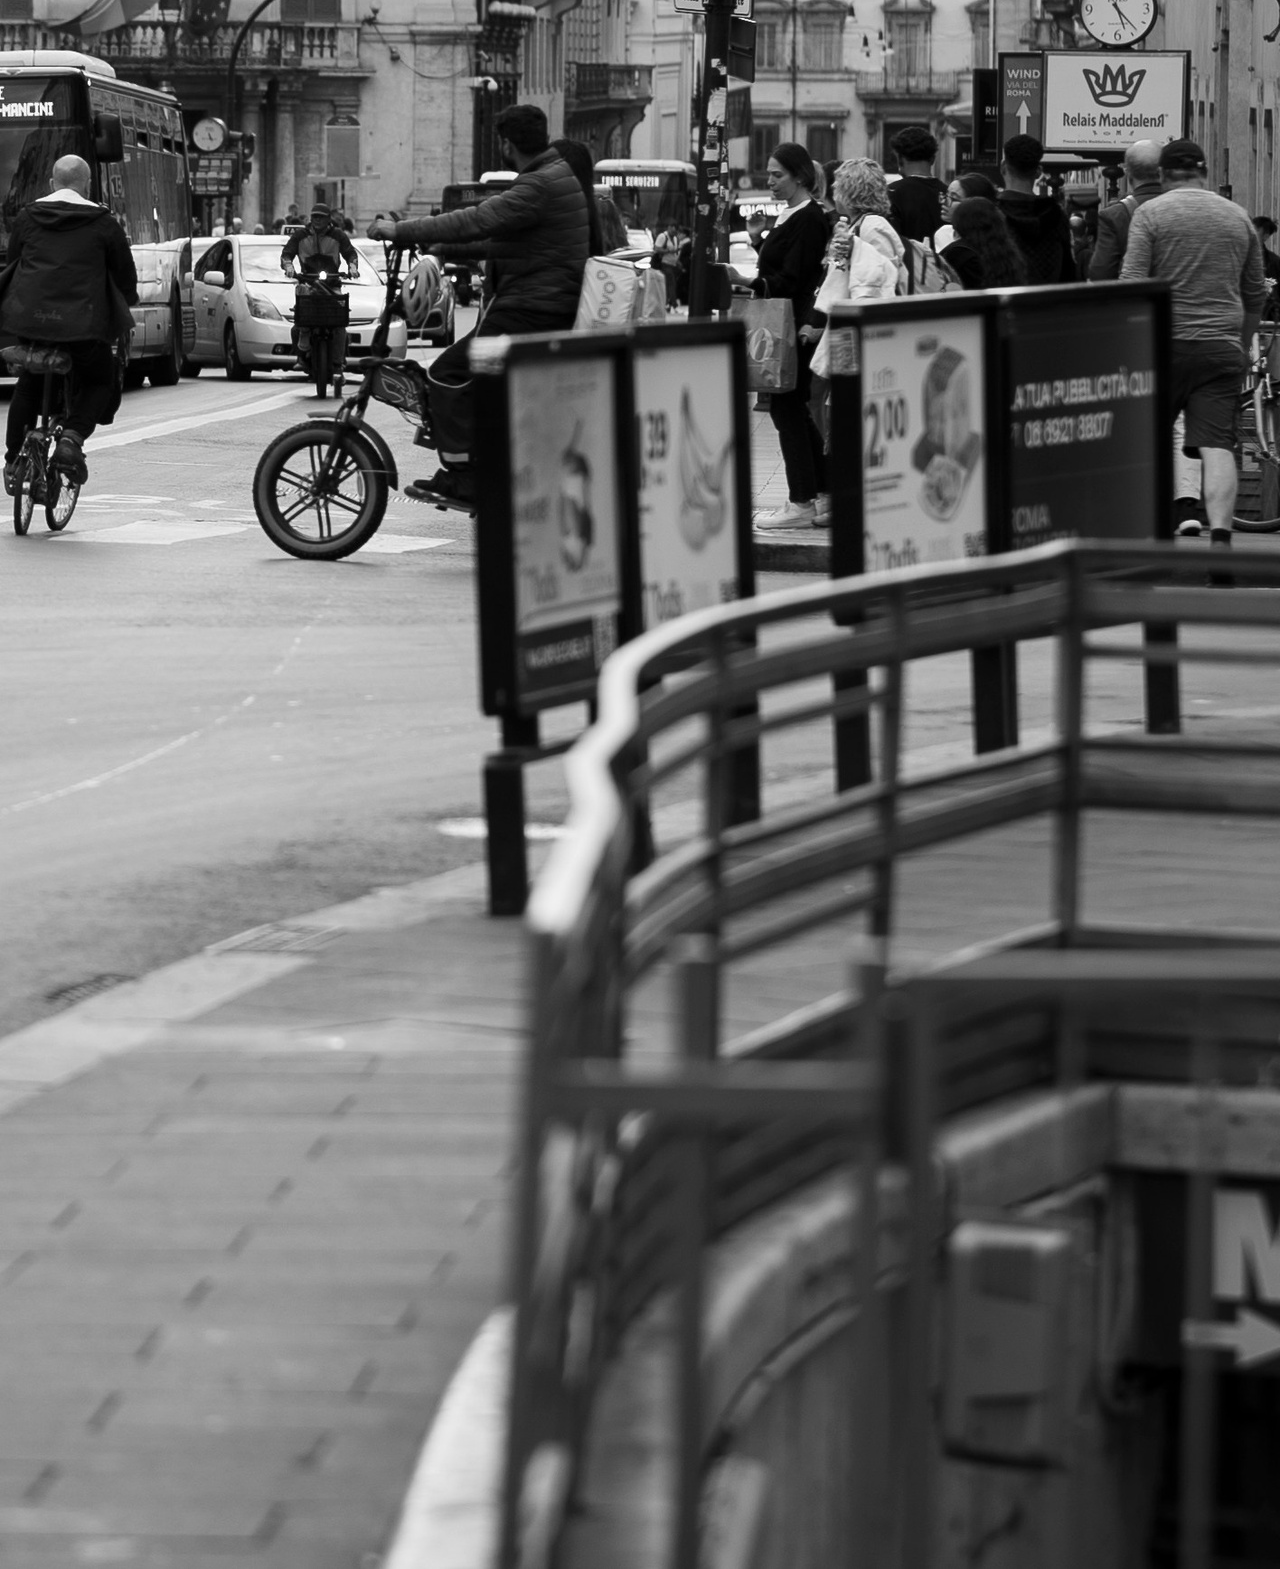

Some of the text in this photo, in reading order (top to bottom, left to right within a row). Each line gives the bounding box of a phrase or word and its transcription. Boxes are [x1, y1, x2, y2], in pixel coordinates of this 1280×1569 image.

[1085, 3, 1150, 16] 9 3
[1114, 30, 1122, 41] 6
[1007, 69, 1041, 79] WIND
[1007, 81, 1038, 89] VIA DEL
[1063, 113, 1097, 127] Relais
[1024, 381, 1051, 409] TUA
[1051, 365, 1128, 405] PUBBLICITÀ
[1129, 369, 1155, 397] QUI
